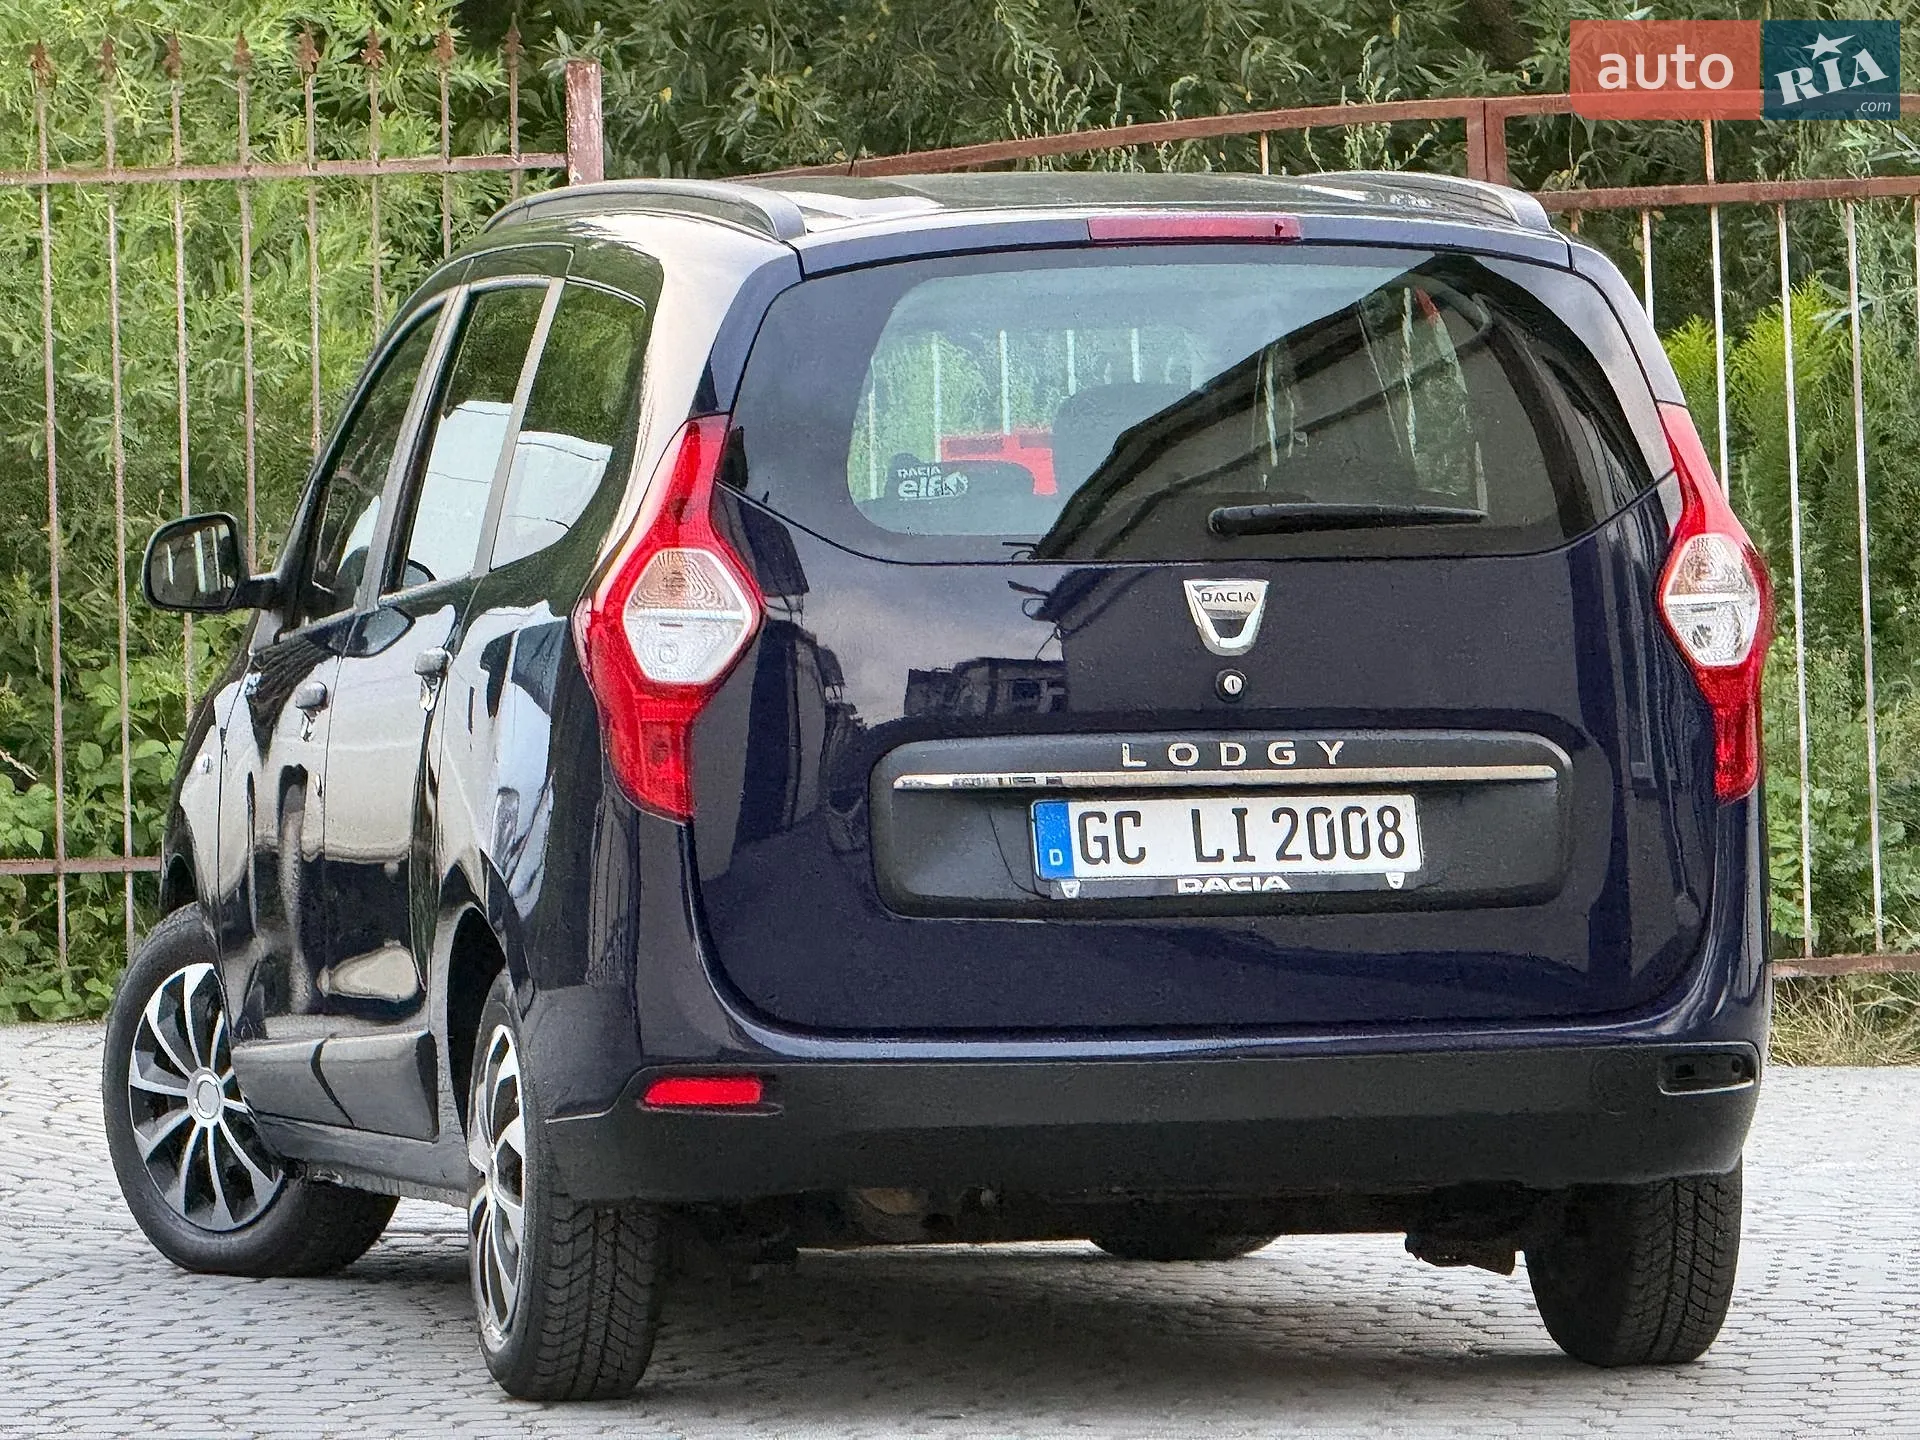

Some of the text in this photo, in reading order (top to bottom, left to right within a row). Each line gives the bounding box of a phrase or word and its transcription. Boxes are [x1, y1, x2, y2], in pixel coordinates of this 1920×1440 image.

[1201, 591, 1257, 603] DACIA
[1121, 740, 1345, 768] LODGY
[1077, 810, 1147, 865] GC
[1049, 849, 1064, 866] D
[1176, 875, 1291, 894] DACIA
